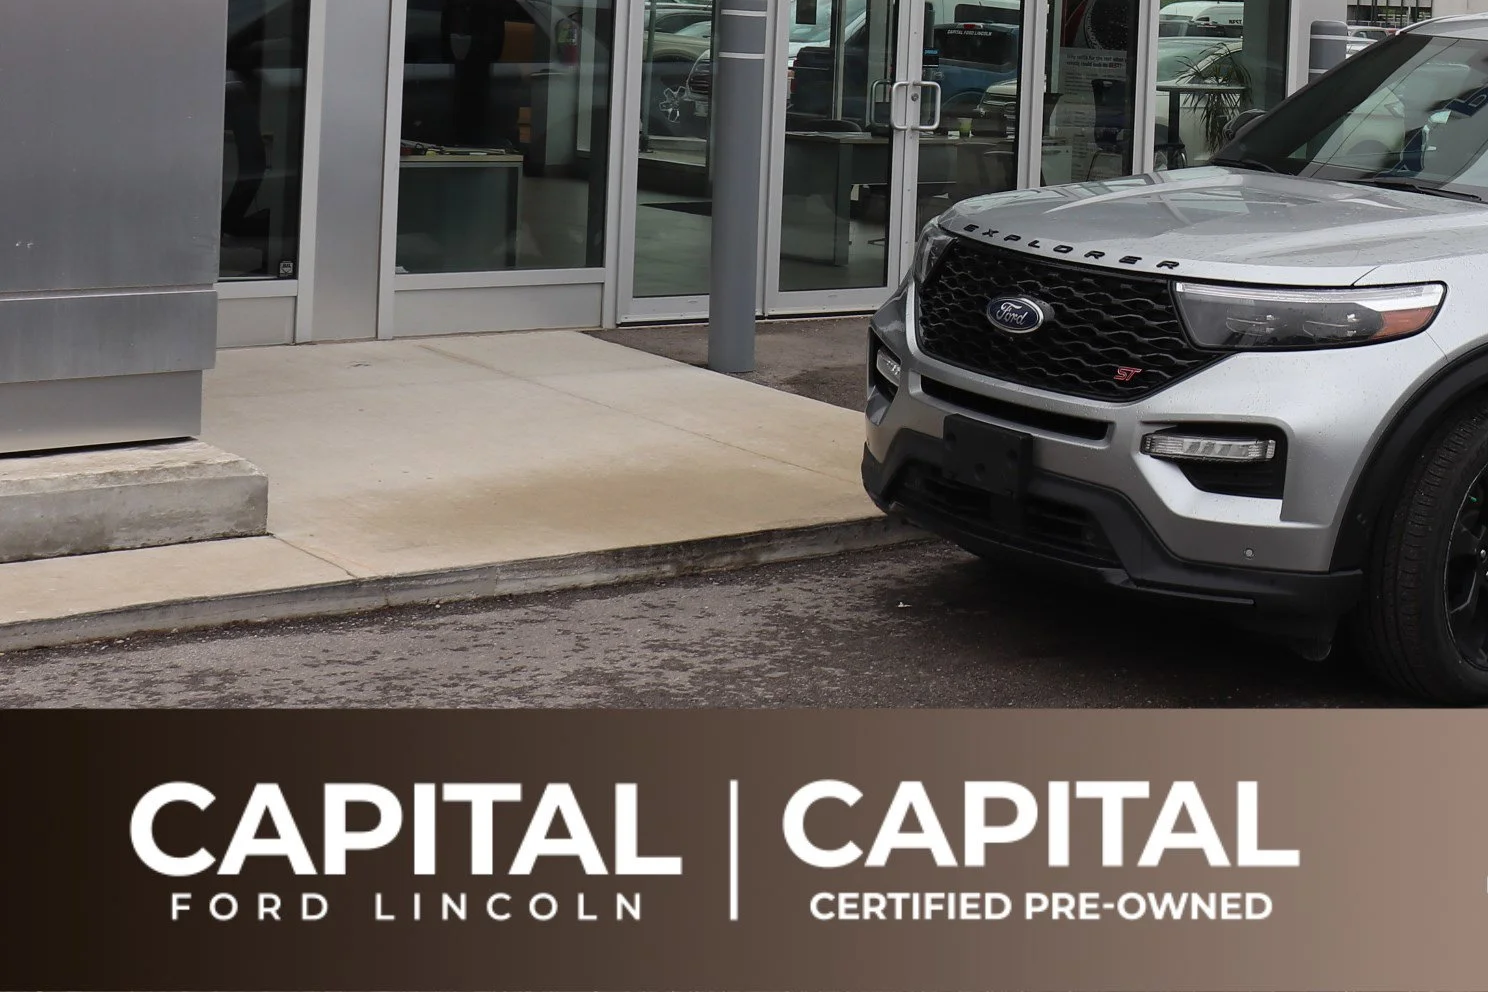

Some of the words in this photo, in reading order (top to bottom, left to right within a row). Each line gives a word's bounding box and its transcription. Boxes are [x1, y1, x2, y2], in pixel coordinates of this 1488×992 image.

[963, 224, 1180, 269] EXPLORER
[995, 301, 1030, 326] Ford
[1113, 366, 1142, 382] ST
